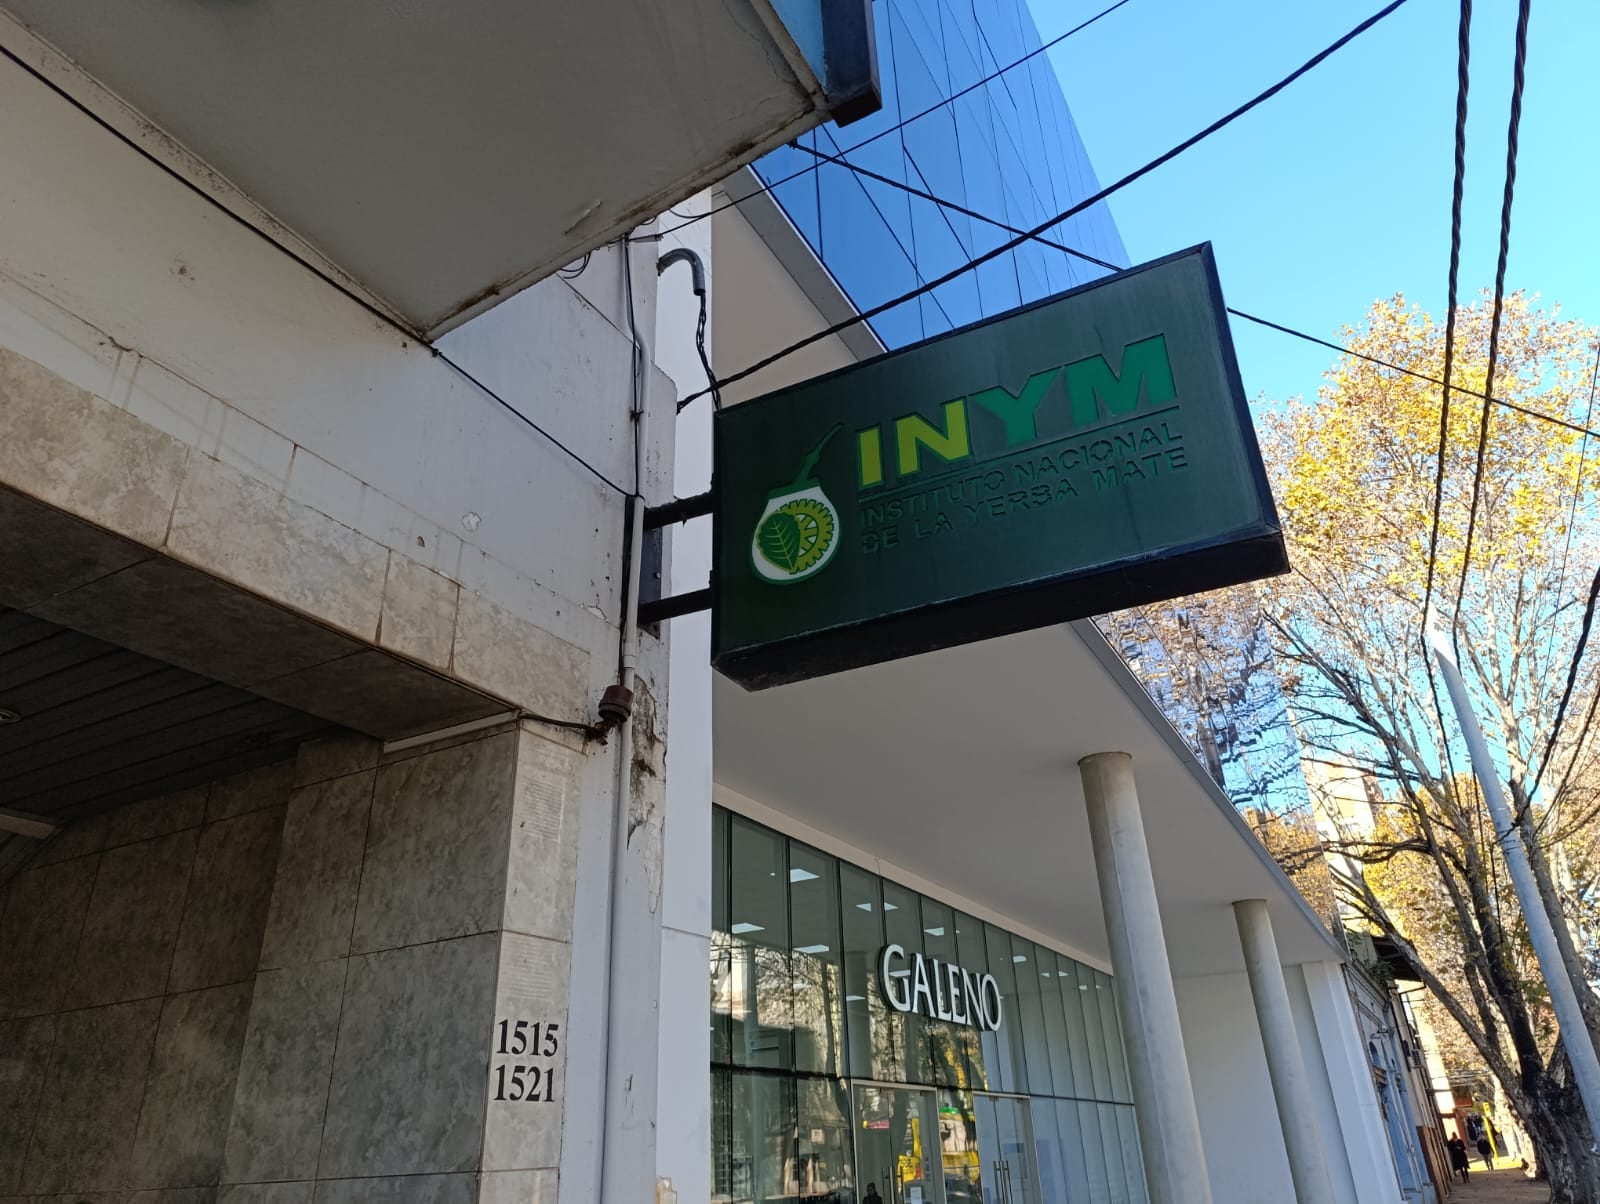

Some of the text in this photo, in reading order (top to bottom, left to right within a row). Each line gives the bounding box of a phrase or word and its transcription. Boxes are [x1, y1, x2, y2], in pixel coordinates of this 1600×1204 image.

[856, 333, 1178, 490] INYM
[860, 422, 1183, 528] INSTITUTO NACIONAL
[862, 446, 1189, 554] DE LA YERBA MATE
[881, 943, 1002, 1032] GALENO
[493, 1064, 556, 1103] 1521
[496, 1018, 560, 1058] 1515
